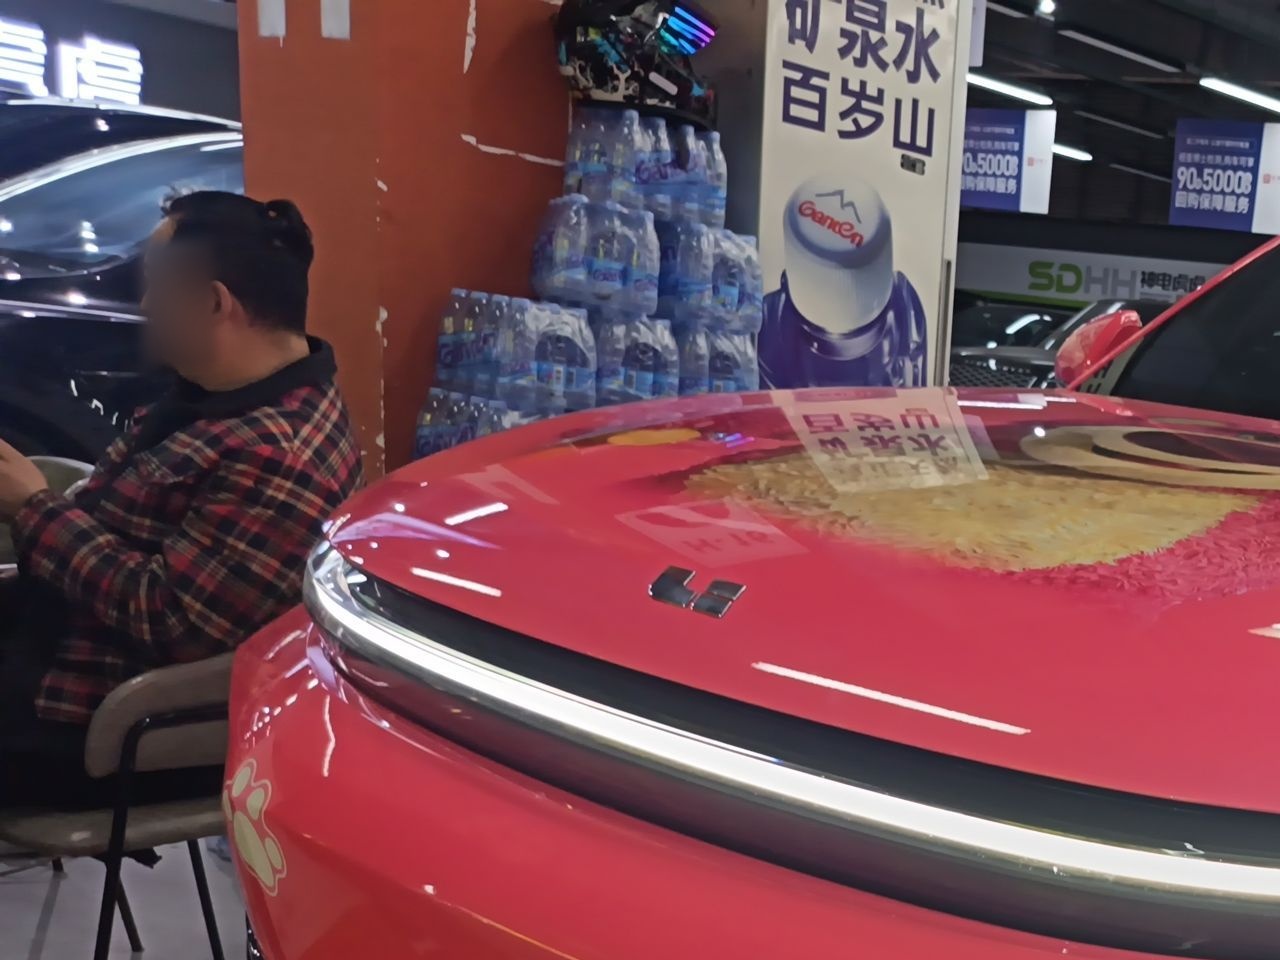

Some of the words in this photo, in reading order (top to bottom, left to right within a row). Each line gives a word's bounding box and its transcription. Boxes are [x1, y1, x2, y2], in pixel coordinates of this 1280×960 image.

[782, 59, 935, 157] 百岁山
[962, 174, 1017, 194] 购保障服务
[1175, 191, 1250, 214] 回购保障服务
[1028, 260, 1138, 300] SDHH
